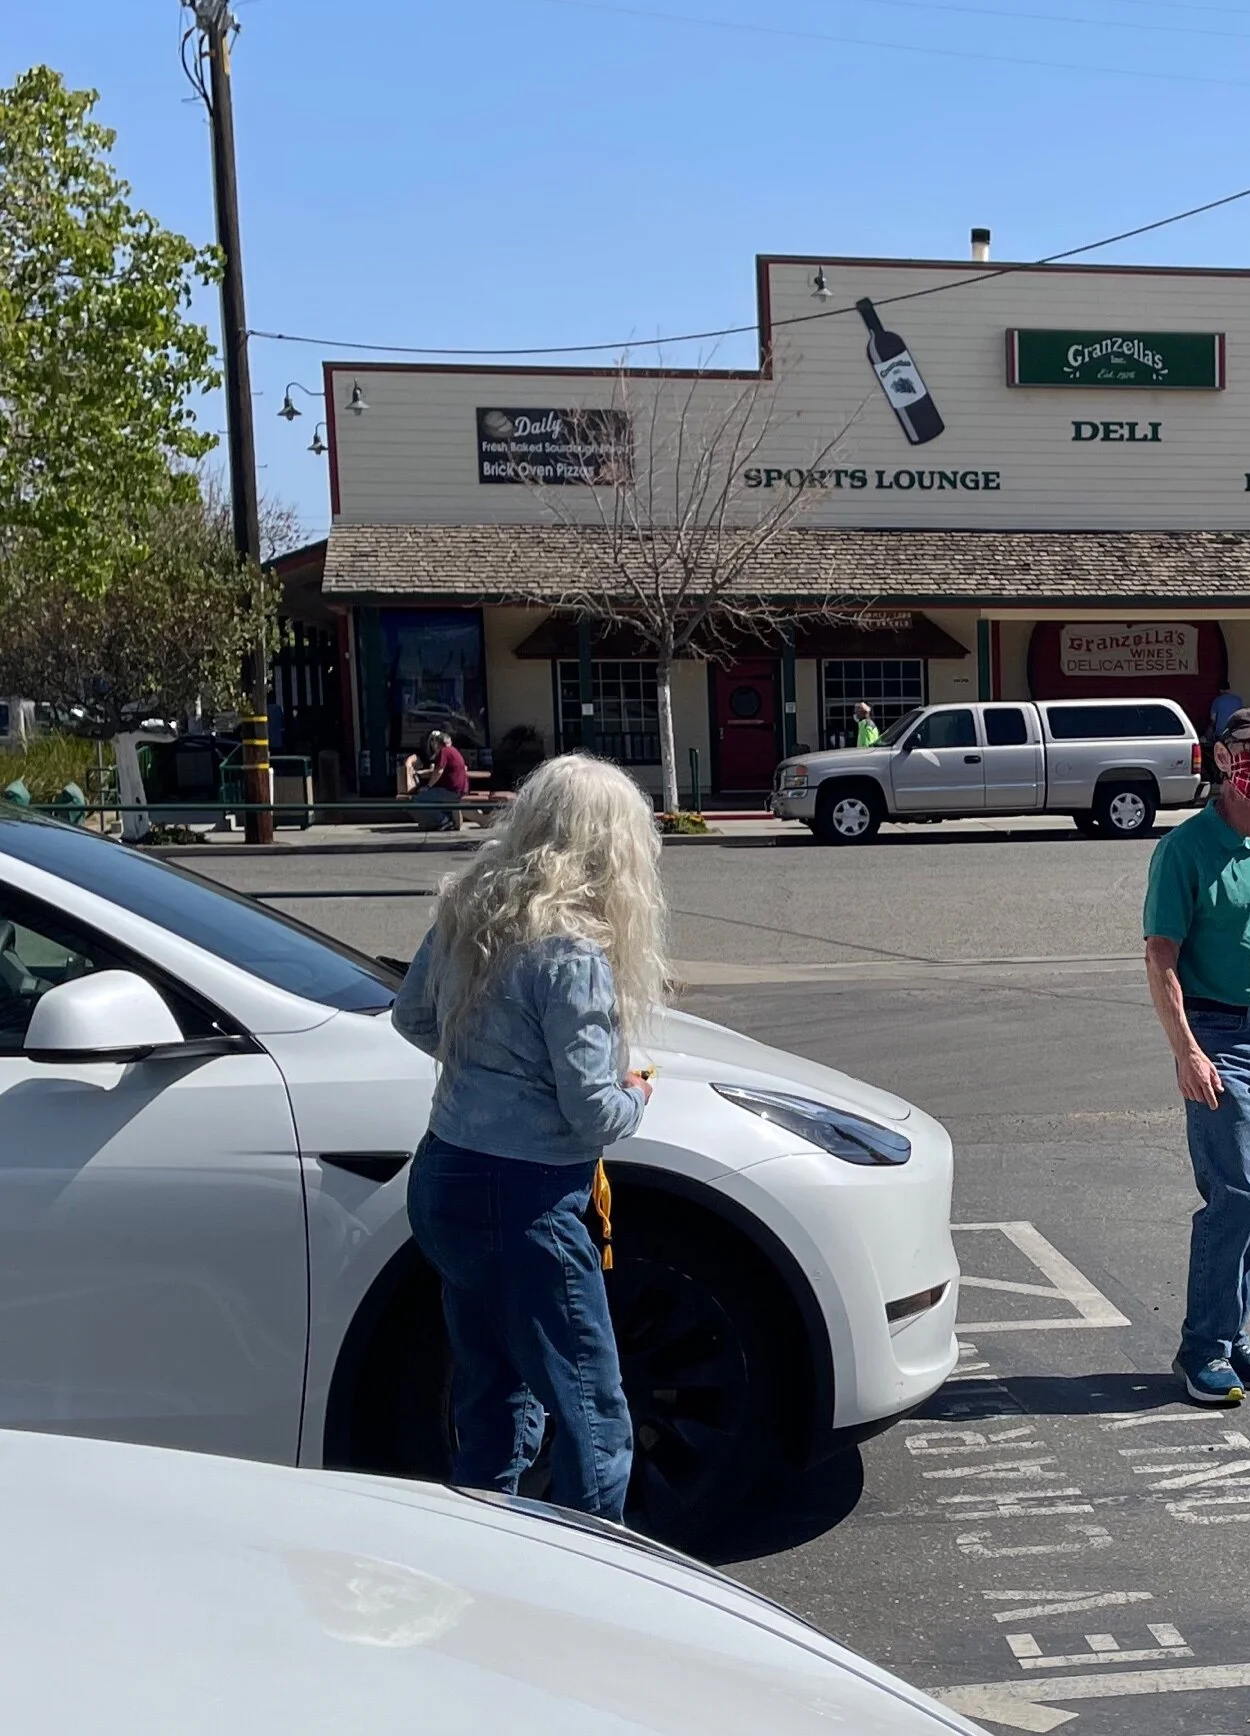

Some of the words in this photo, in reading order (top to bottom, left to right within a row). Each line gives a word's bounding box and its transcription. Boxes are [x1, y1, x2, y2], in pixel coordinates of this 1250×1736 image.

[1067, 337, 1163, 369] Granzella's
[513, 411, 563, 438] Daily
[1071, 421, 1162, 442] DELI
[482, 441, 508, 452] Fresh
[510, 442, 543, 453] Baked
[483, 461, 514, 477] Brick
[518, 462, 554, 477] Oven
[743, 468, 868, 488] SPORTS
[875, 470, 1001, 490] LOUNGE
[1068, 630, 1185, 652] Granzella's
[1130, 648, 1173, 658] WINES
[1067, 659, 1188, 671] DELICATESSEN
[981, 1589, 1195, 1669] EV
